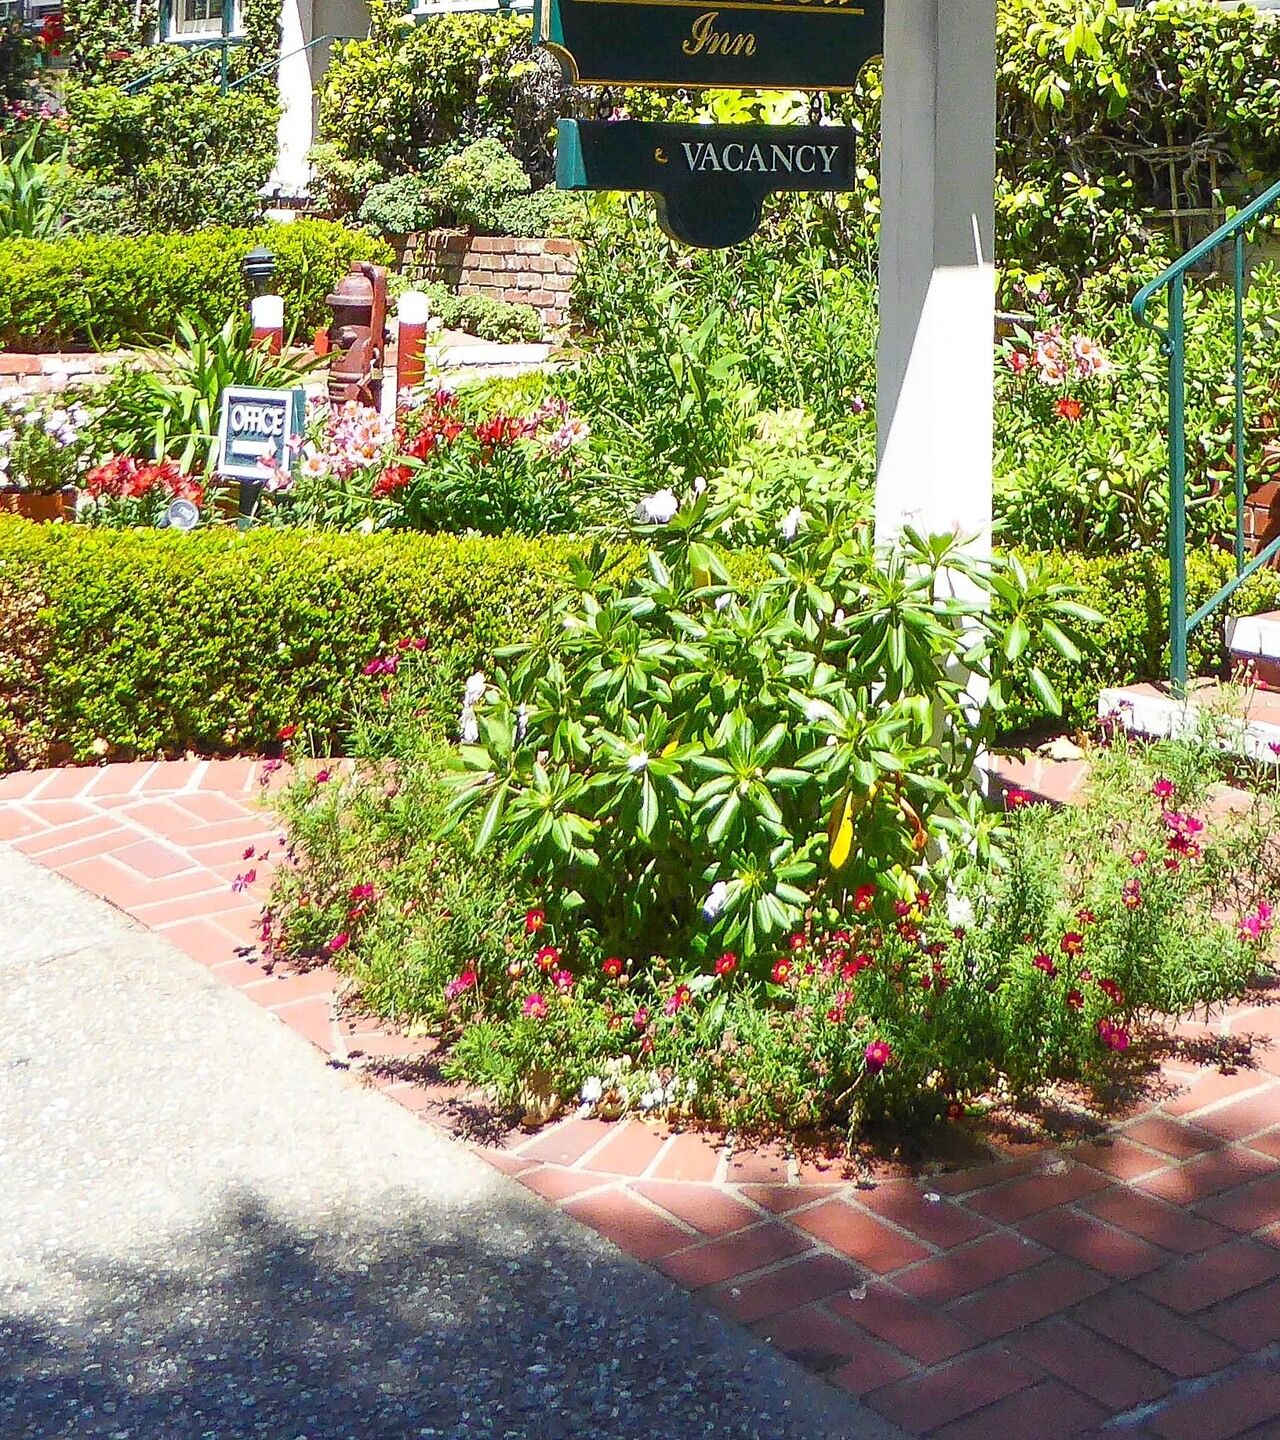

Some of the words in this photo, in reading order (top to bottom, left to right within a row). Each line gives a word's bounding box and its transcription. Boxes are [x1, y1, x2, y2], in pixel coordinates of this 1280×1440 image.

[681, 12, 757, 57] Inn
[681, 141, 840, 174] VACANCY
[231, 404, 285, 436] OFFICE
